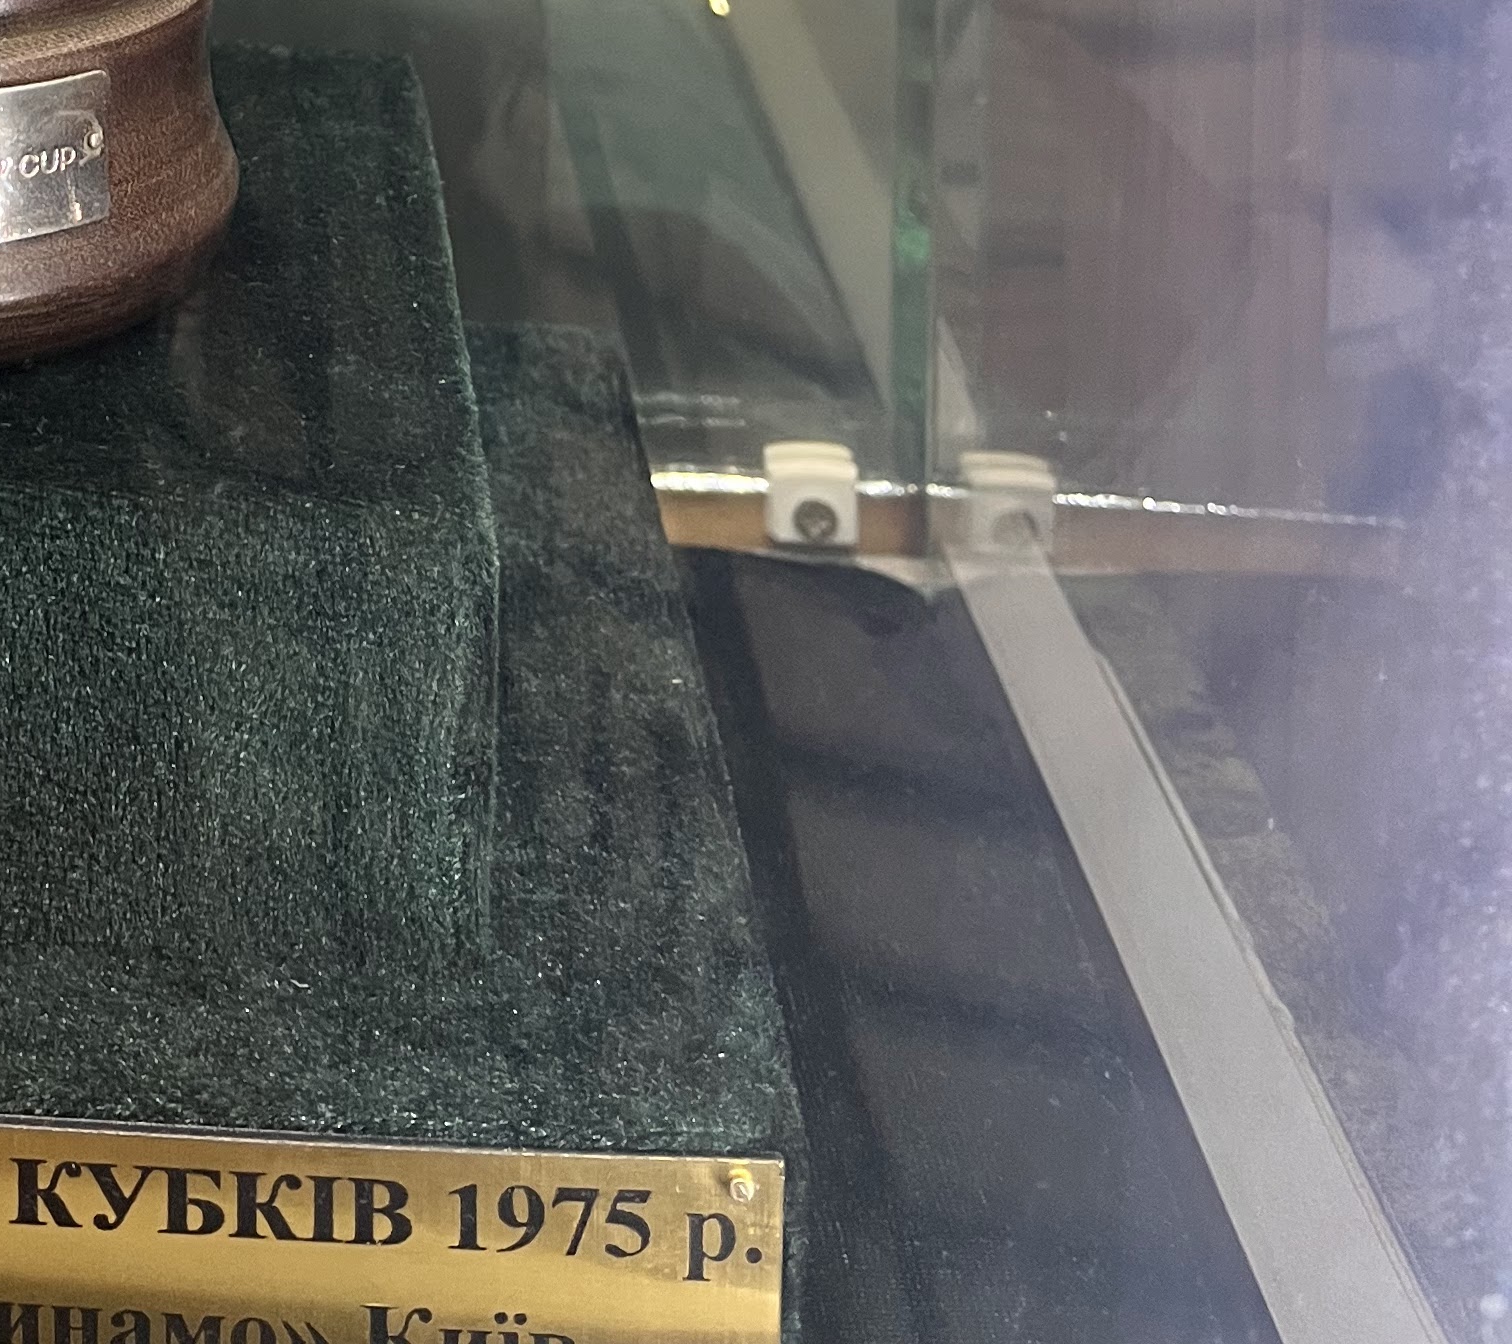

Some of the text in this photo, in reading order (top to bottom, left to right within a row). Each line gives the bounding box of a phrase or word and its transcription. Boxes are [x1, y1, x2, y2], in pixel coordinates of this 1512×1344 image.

[18, 146, 77, 179] CUP
[9, 1157, 414, 1248] КУБКІВ
[446, 1183, 654, 1259] 1975
[683, 1200, 765, 1283] р.
